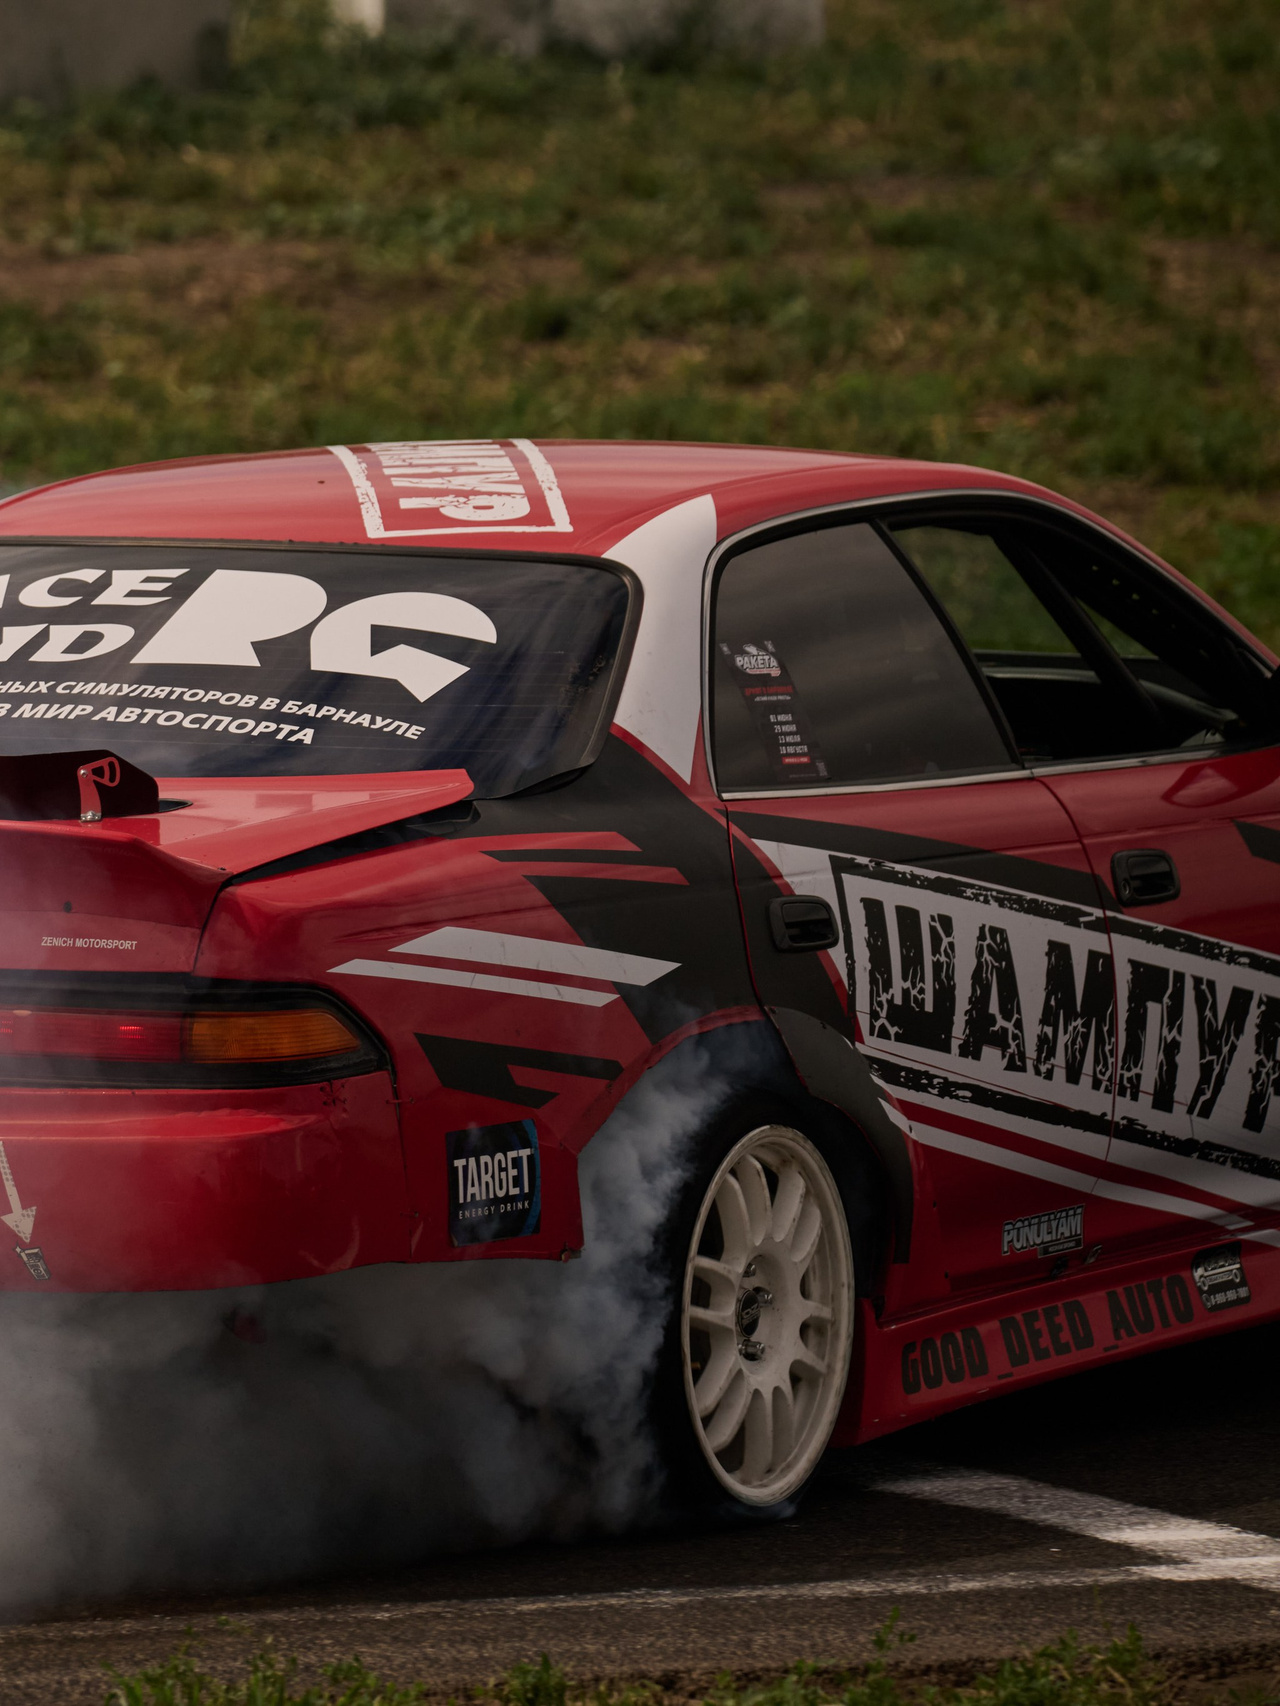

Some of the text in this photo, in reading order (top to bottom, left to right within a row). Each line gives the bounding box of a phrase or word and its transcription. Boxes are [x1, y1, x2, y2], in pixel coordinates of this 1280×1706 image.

[735, 654, 779, 670] РАКЕТА
[11, 703, 94, 721] МИР
[91, 706, 315, 745] АВТОСПОРТА
[55, 681, 259, 709] СИМУЛЯТОРОВ
[258, 697, 280, 711] В
[280, 700, 425, 741] БАРНАУЛЕ
[41, 936, 137, 950] ZENICH MOTORSPORT
[453, 1147, 531, 1204] TARGET
[458, 1200, 530, 1220] ENERGY DRINK
[1002, 1205, 1084, 1253] PONULYAM
